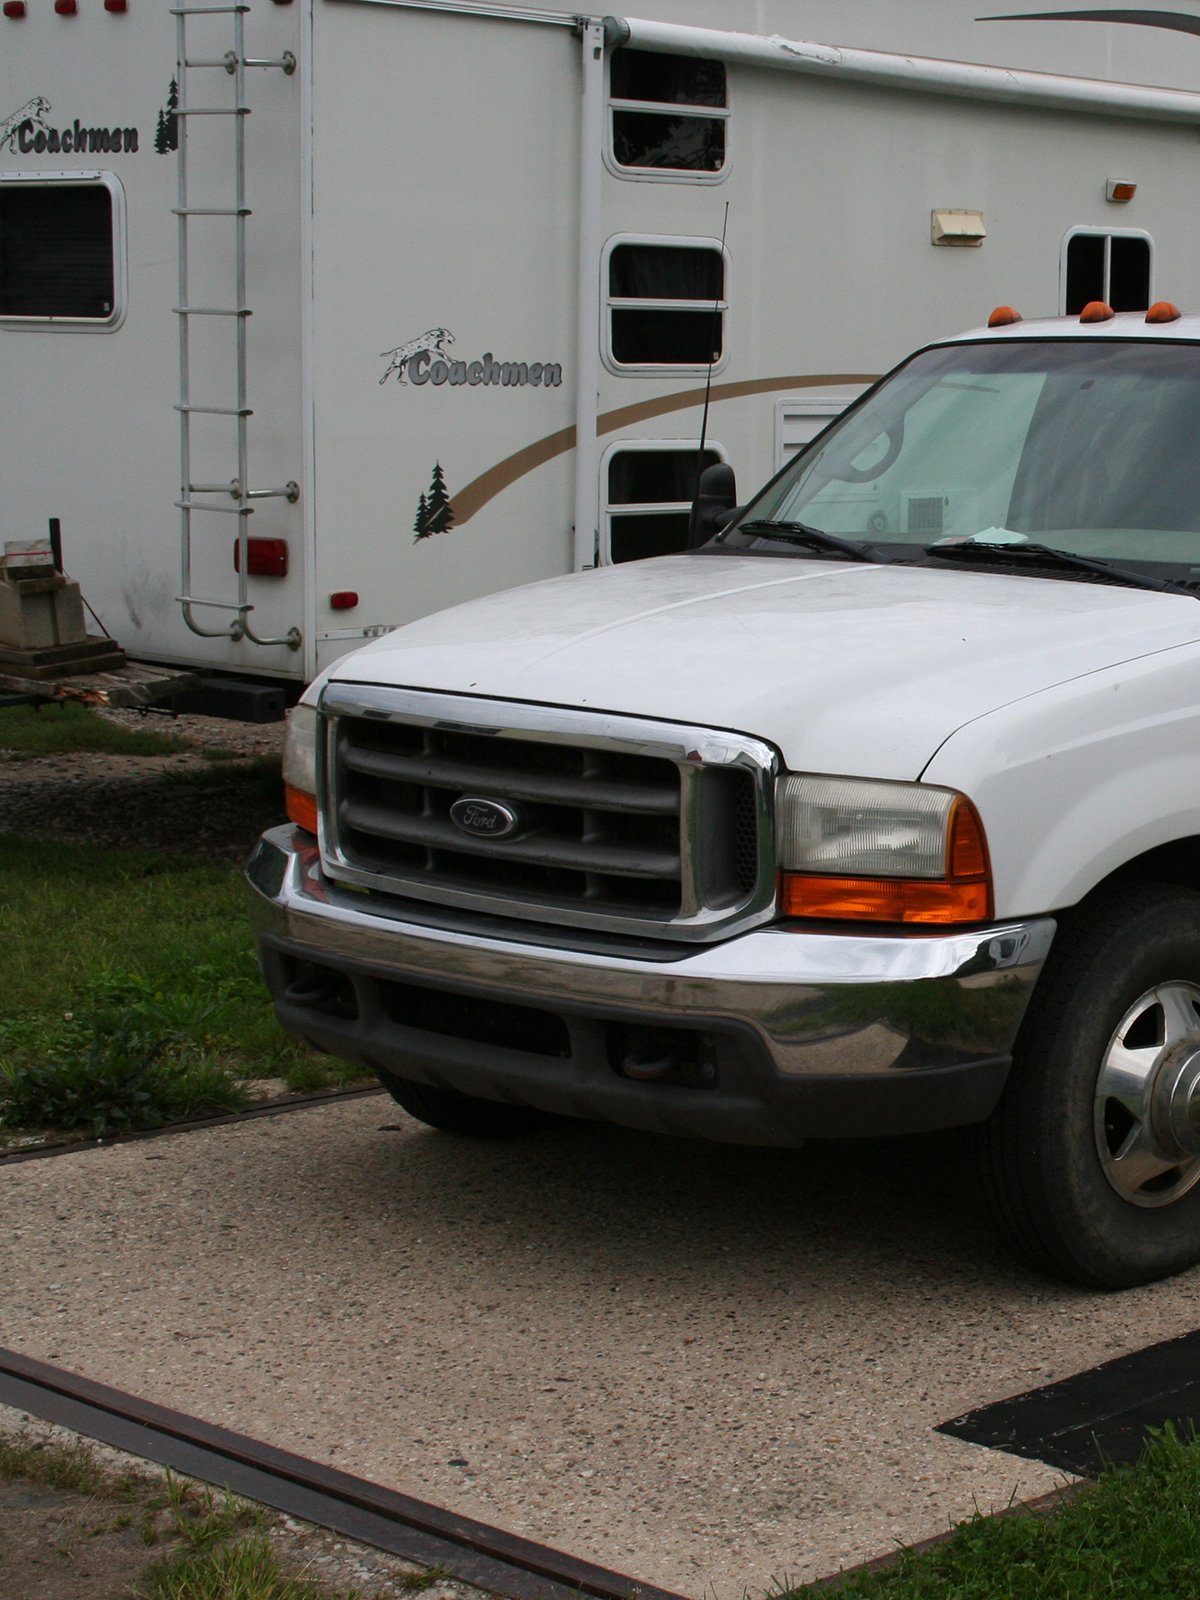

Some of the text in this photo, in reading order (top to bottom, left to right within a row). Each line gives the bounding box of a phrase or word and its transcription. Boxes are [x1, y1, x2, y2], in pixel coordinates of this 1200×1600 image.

[18, 118, 139, 153] Coachmen
[408, 351, 562, 387] Coachmen
[463, 804, 497, 829] Ford
